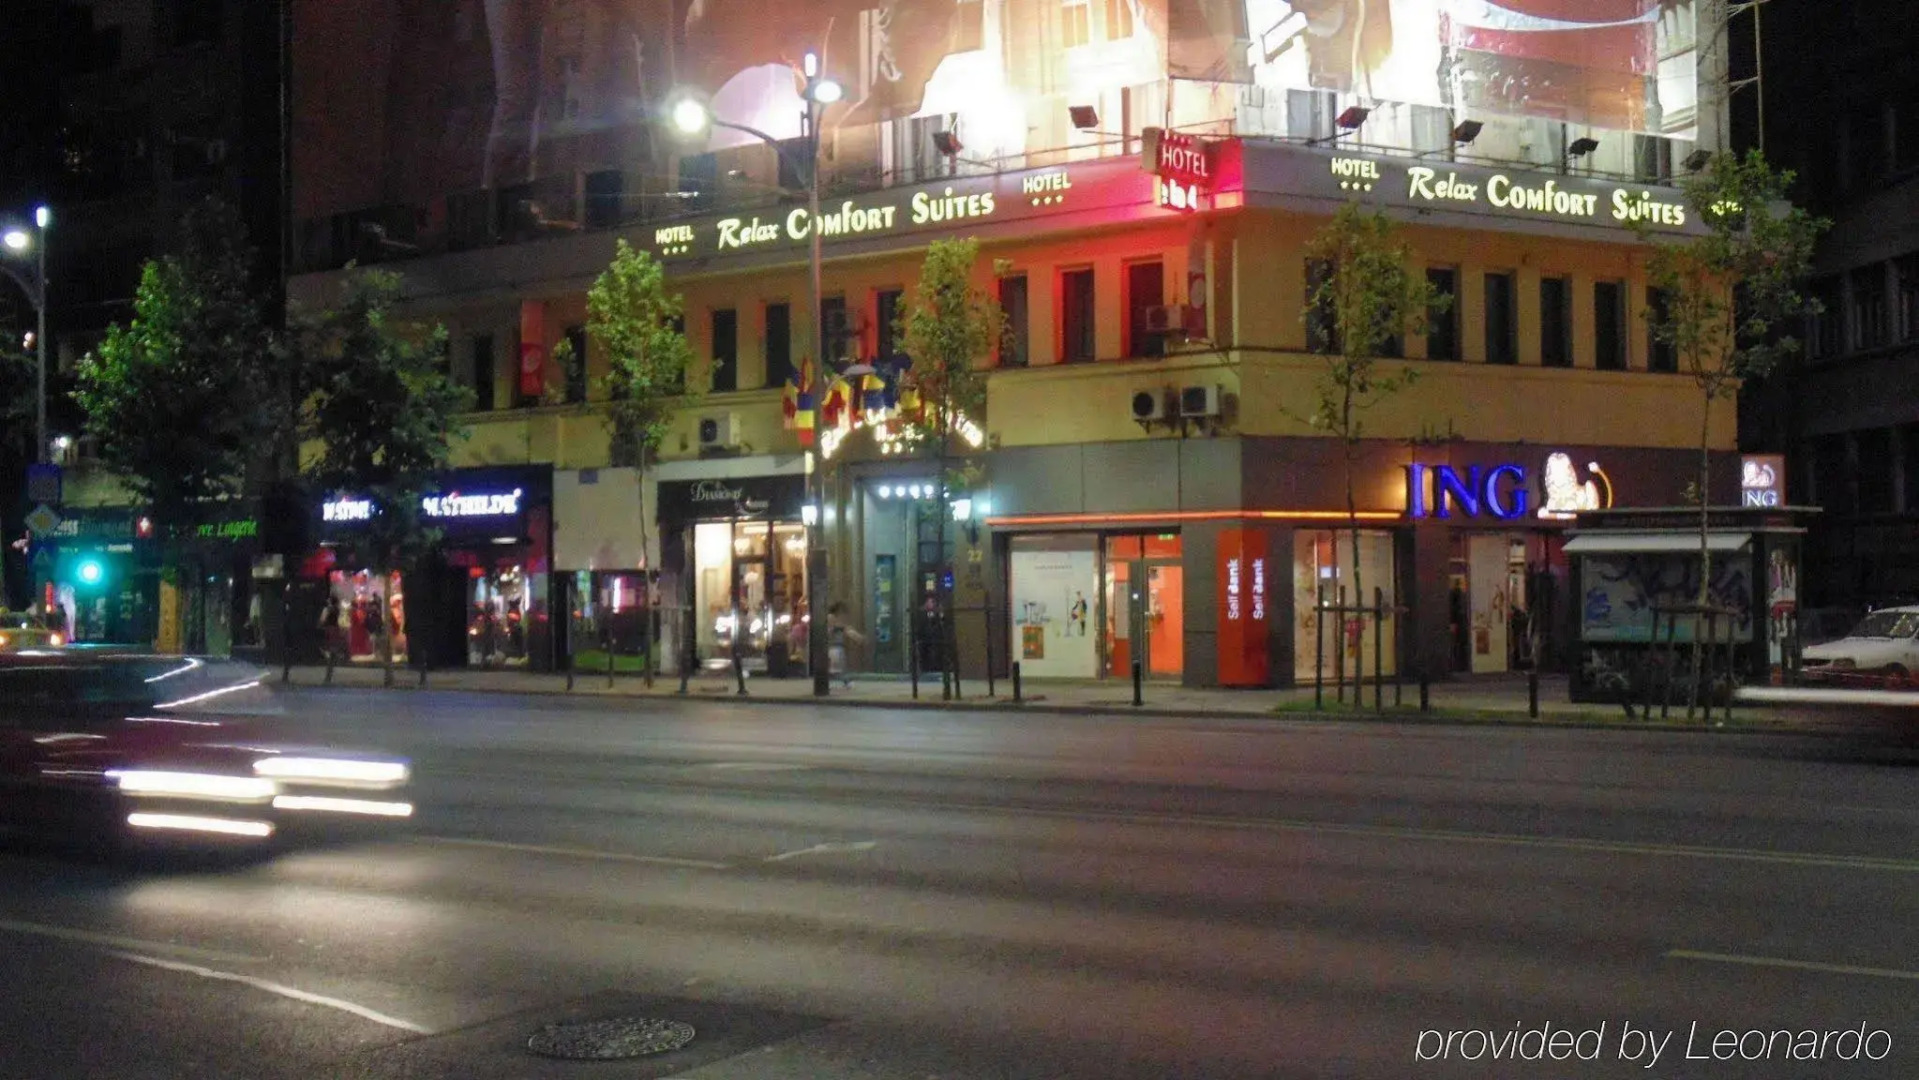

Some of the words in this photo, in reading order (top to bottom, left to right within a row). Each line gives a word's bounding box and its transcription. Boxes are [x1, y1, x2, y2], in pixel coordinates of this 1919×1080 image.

[1162, 144, 1208, 177] HOTEL
[1331, 157, 1380, 178] HOTEL
[1023, 172, 1072, 194] HOTEL
[1407, 166, 1478, 201] Relax
[655, 225, 695, 245] HOTEL
[716, 217, 779, 250] Relax
[1401, 463, 1529, 520] ING
